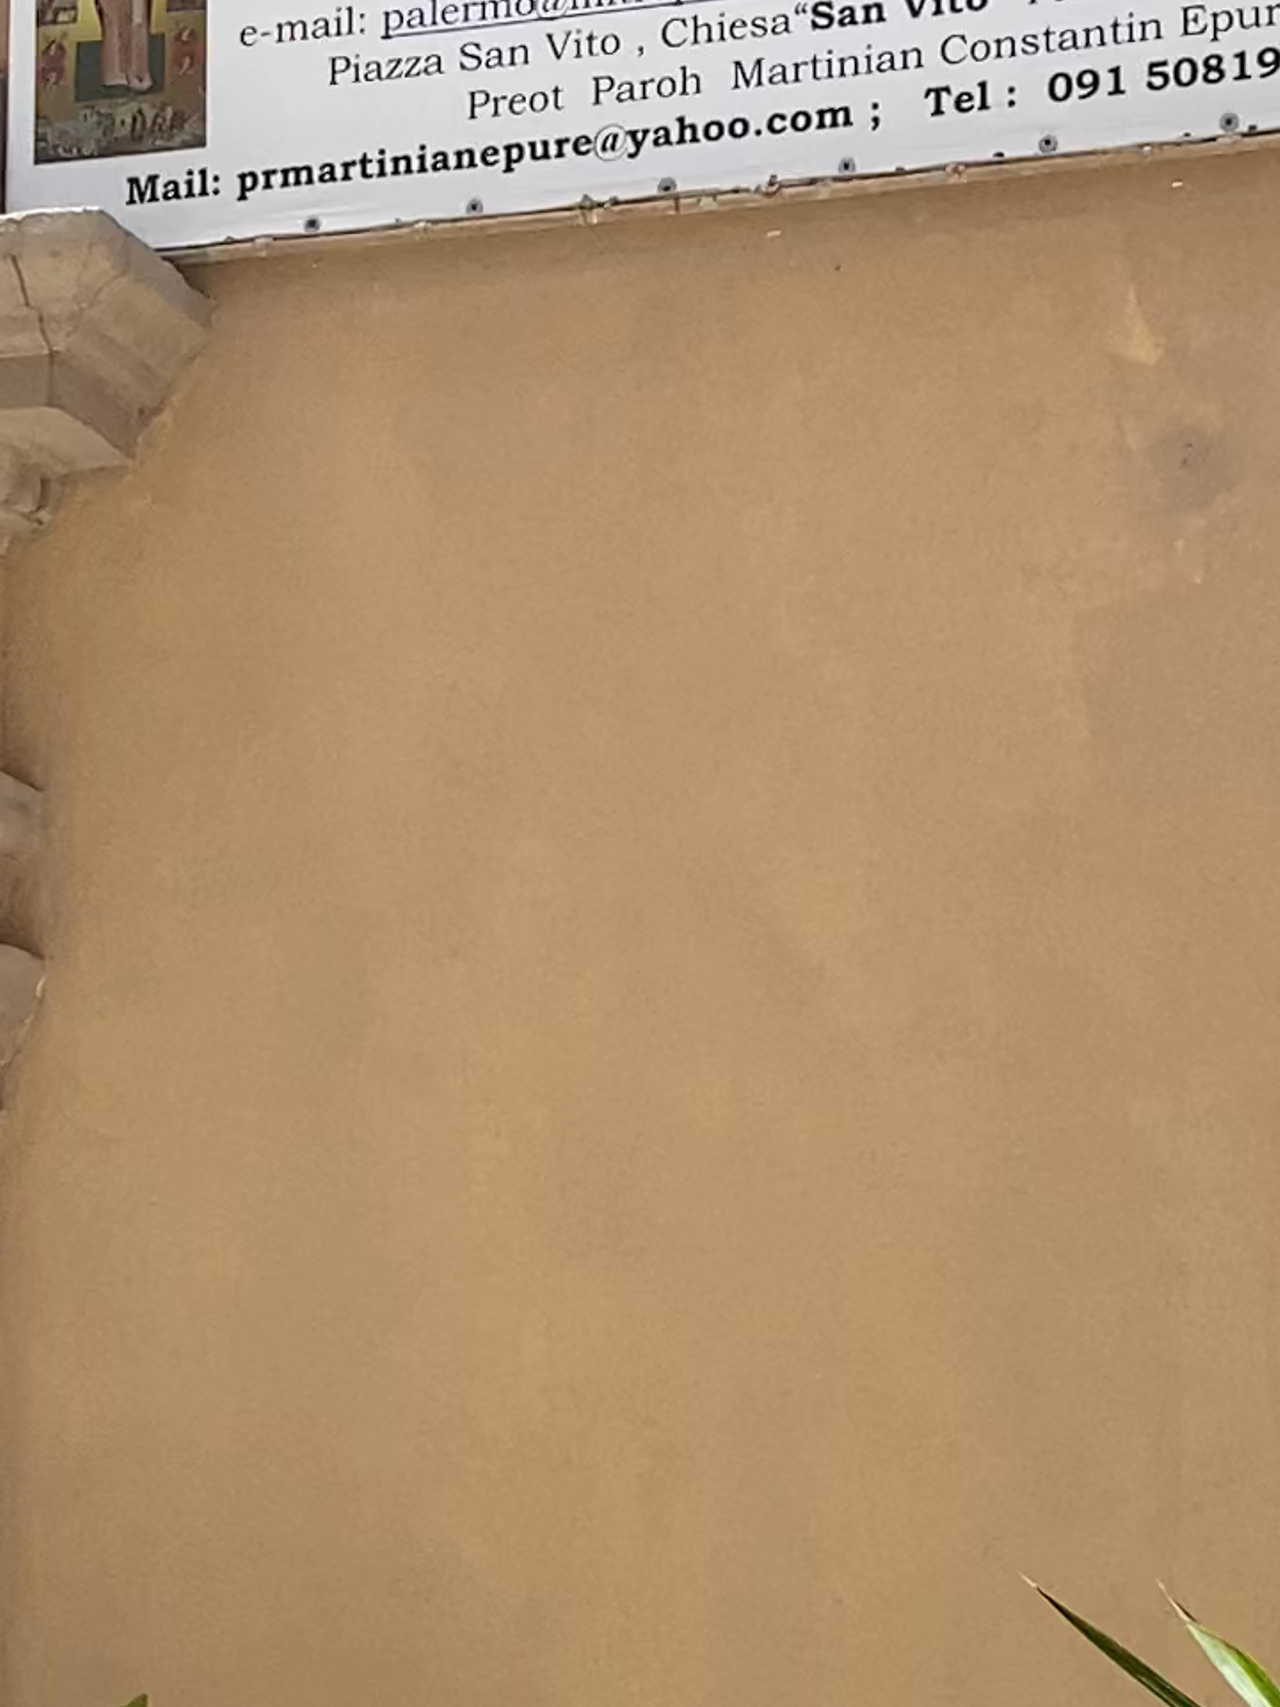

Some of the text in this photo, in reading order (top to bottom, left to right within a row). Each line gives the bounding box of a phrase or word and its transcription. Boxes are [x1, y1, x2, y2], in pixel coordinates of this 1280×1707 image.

[239, 4, 367, 48] e-mail:
[328, 52, 447, 86] Piazza
[458, 40, 531, 73] San
[544, 27, 622, 62] Vito
[467, 83, 566, 121] Preot
[590, 64, 704, 108] Paroh
[729, 42, 926, 92] Martinian
[939, 10, 1166, 67] Constantin
[124, 166, 222, 205] Mail:
[234, 104, 855, 203] prmartinianepure@yahoo.com
[922, 78, 993, 118] Tel
[1046, 64, 1127, 104] 091
